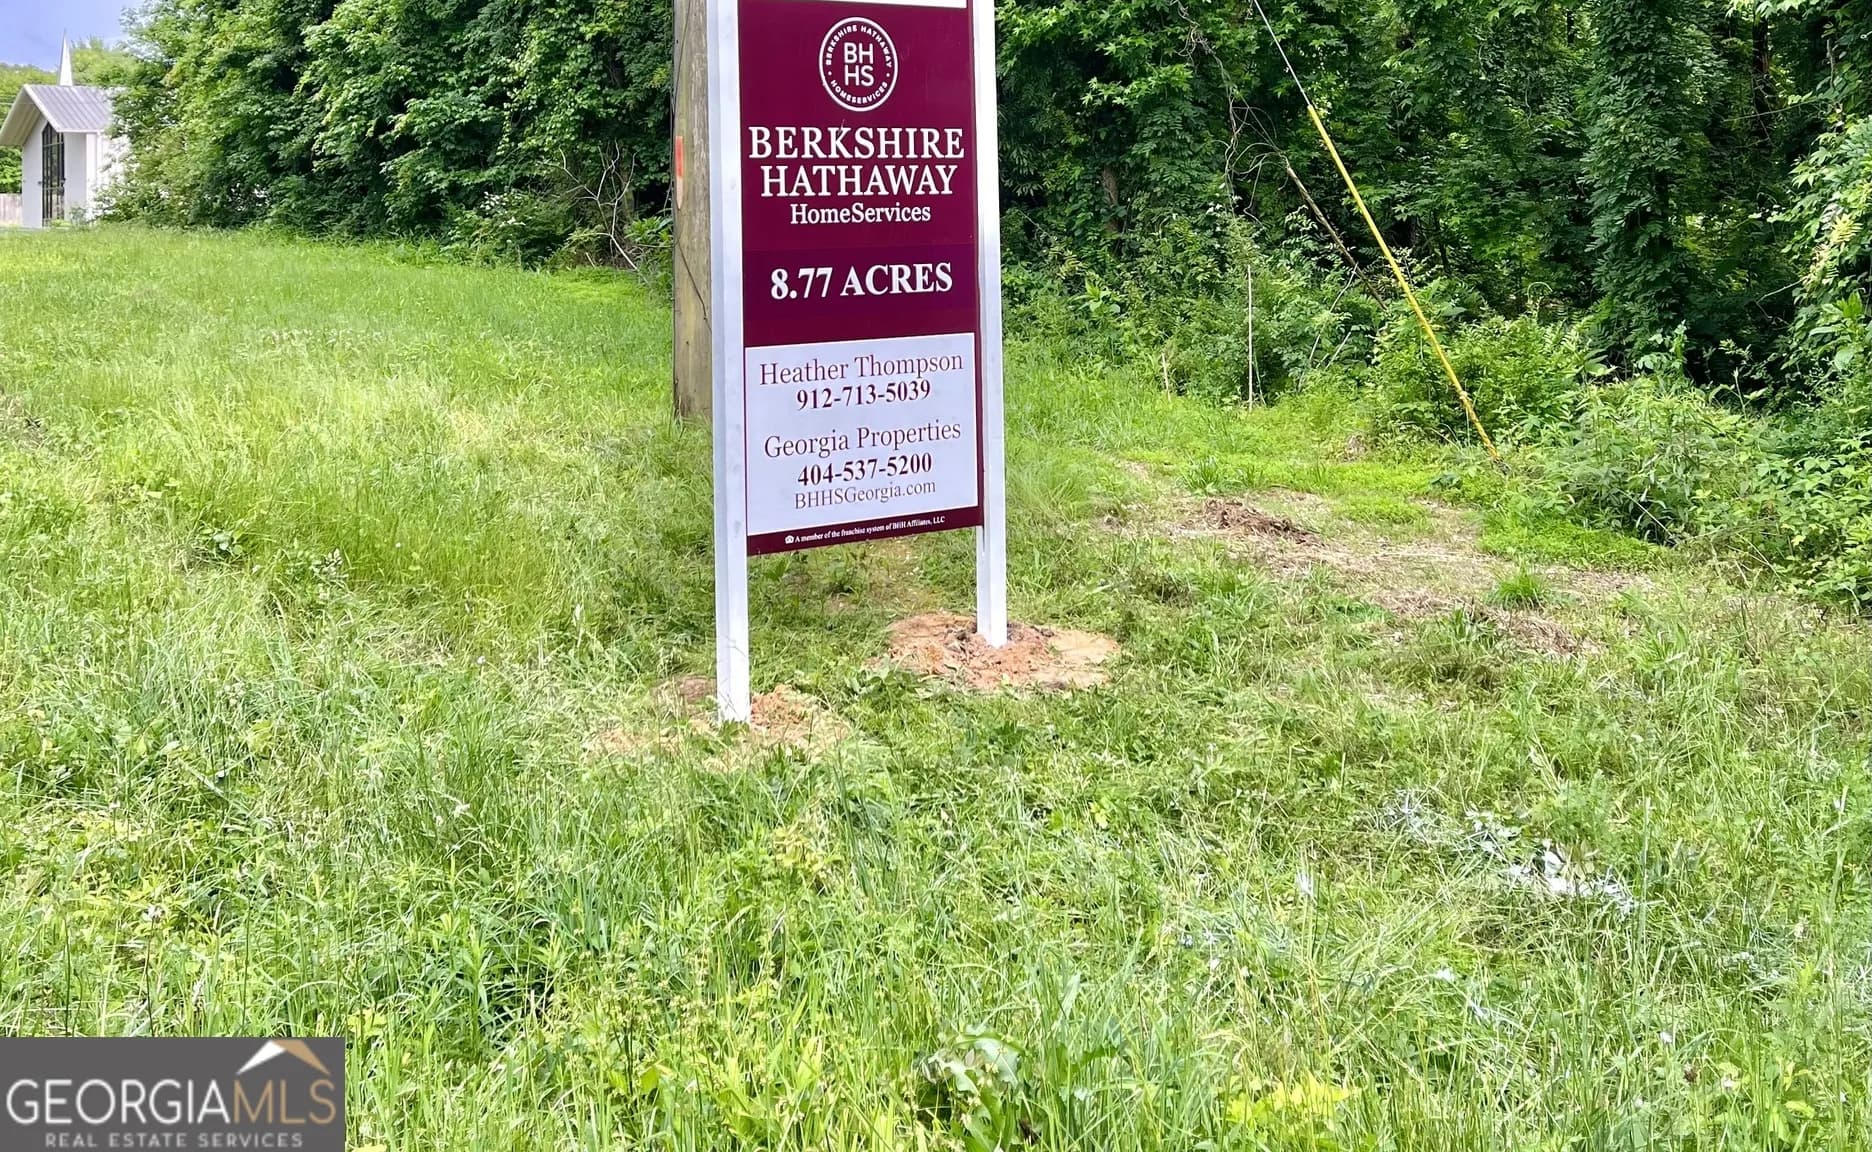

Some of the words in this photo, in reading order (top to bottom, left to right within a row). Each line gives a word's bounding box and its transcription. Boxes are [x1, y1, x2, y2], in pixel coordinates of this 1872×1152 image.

[825, 24, 858, 66] BERKSHIRE
[860, 25, 892, 68] HATHAWAY
[844, 42, 874, 64] BH
[830, 79, 888, 105] HOMESERVICES
[844, 64, 874, 87] HS
[748, 126, 965, 159] BERKSHIRE
[760, 164, 958, 197] HATHAWAY
[790, 202, 931, 225] HomeServices
[770, 266, 833, 300] 8.77
[840, 262, 953, 297] ACRES
[759, 358, 848, 386] Heather
[854, 353, 964, 378] Thompson
[796, 379, 931, 411] 912-713-5039
[764, 429, 849, 459] Georgia
[856, 419, 961, 451] Properties
[797, 452, 932, 486] 404-537-5200
[795, 480, 936, 510] BHHSGeorgia.com
